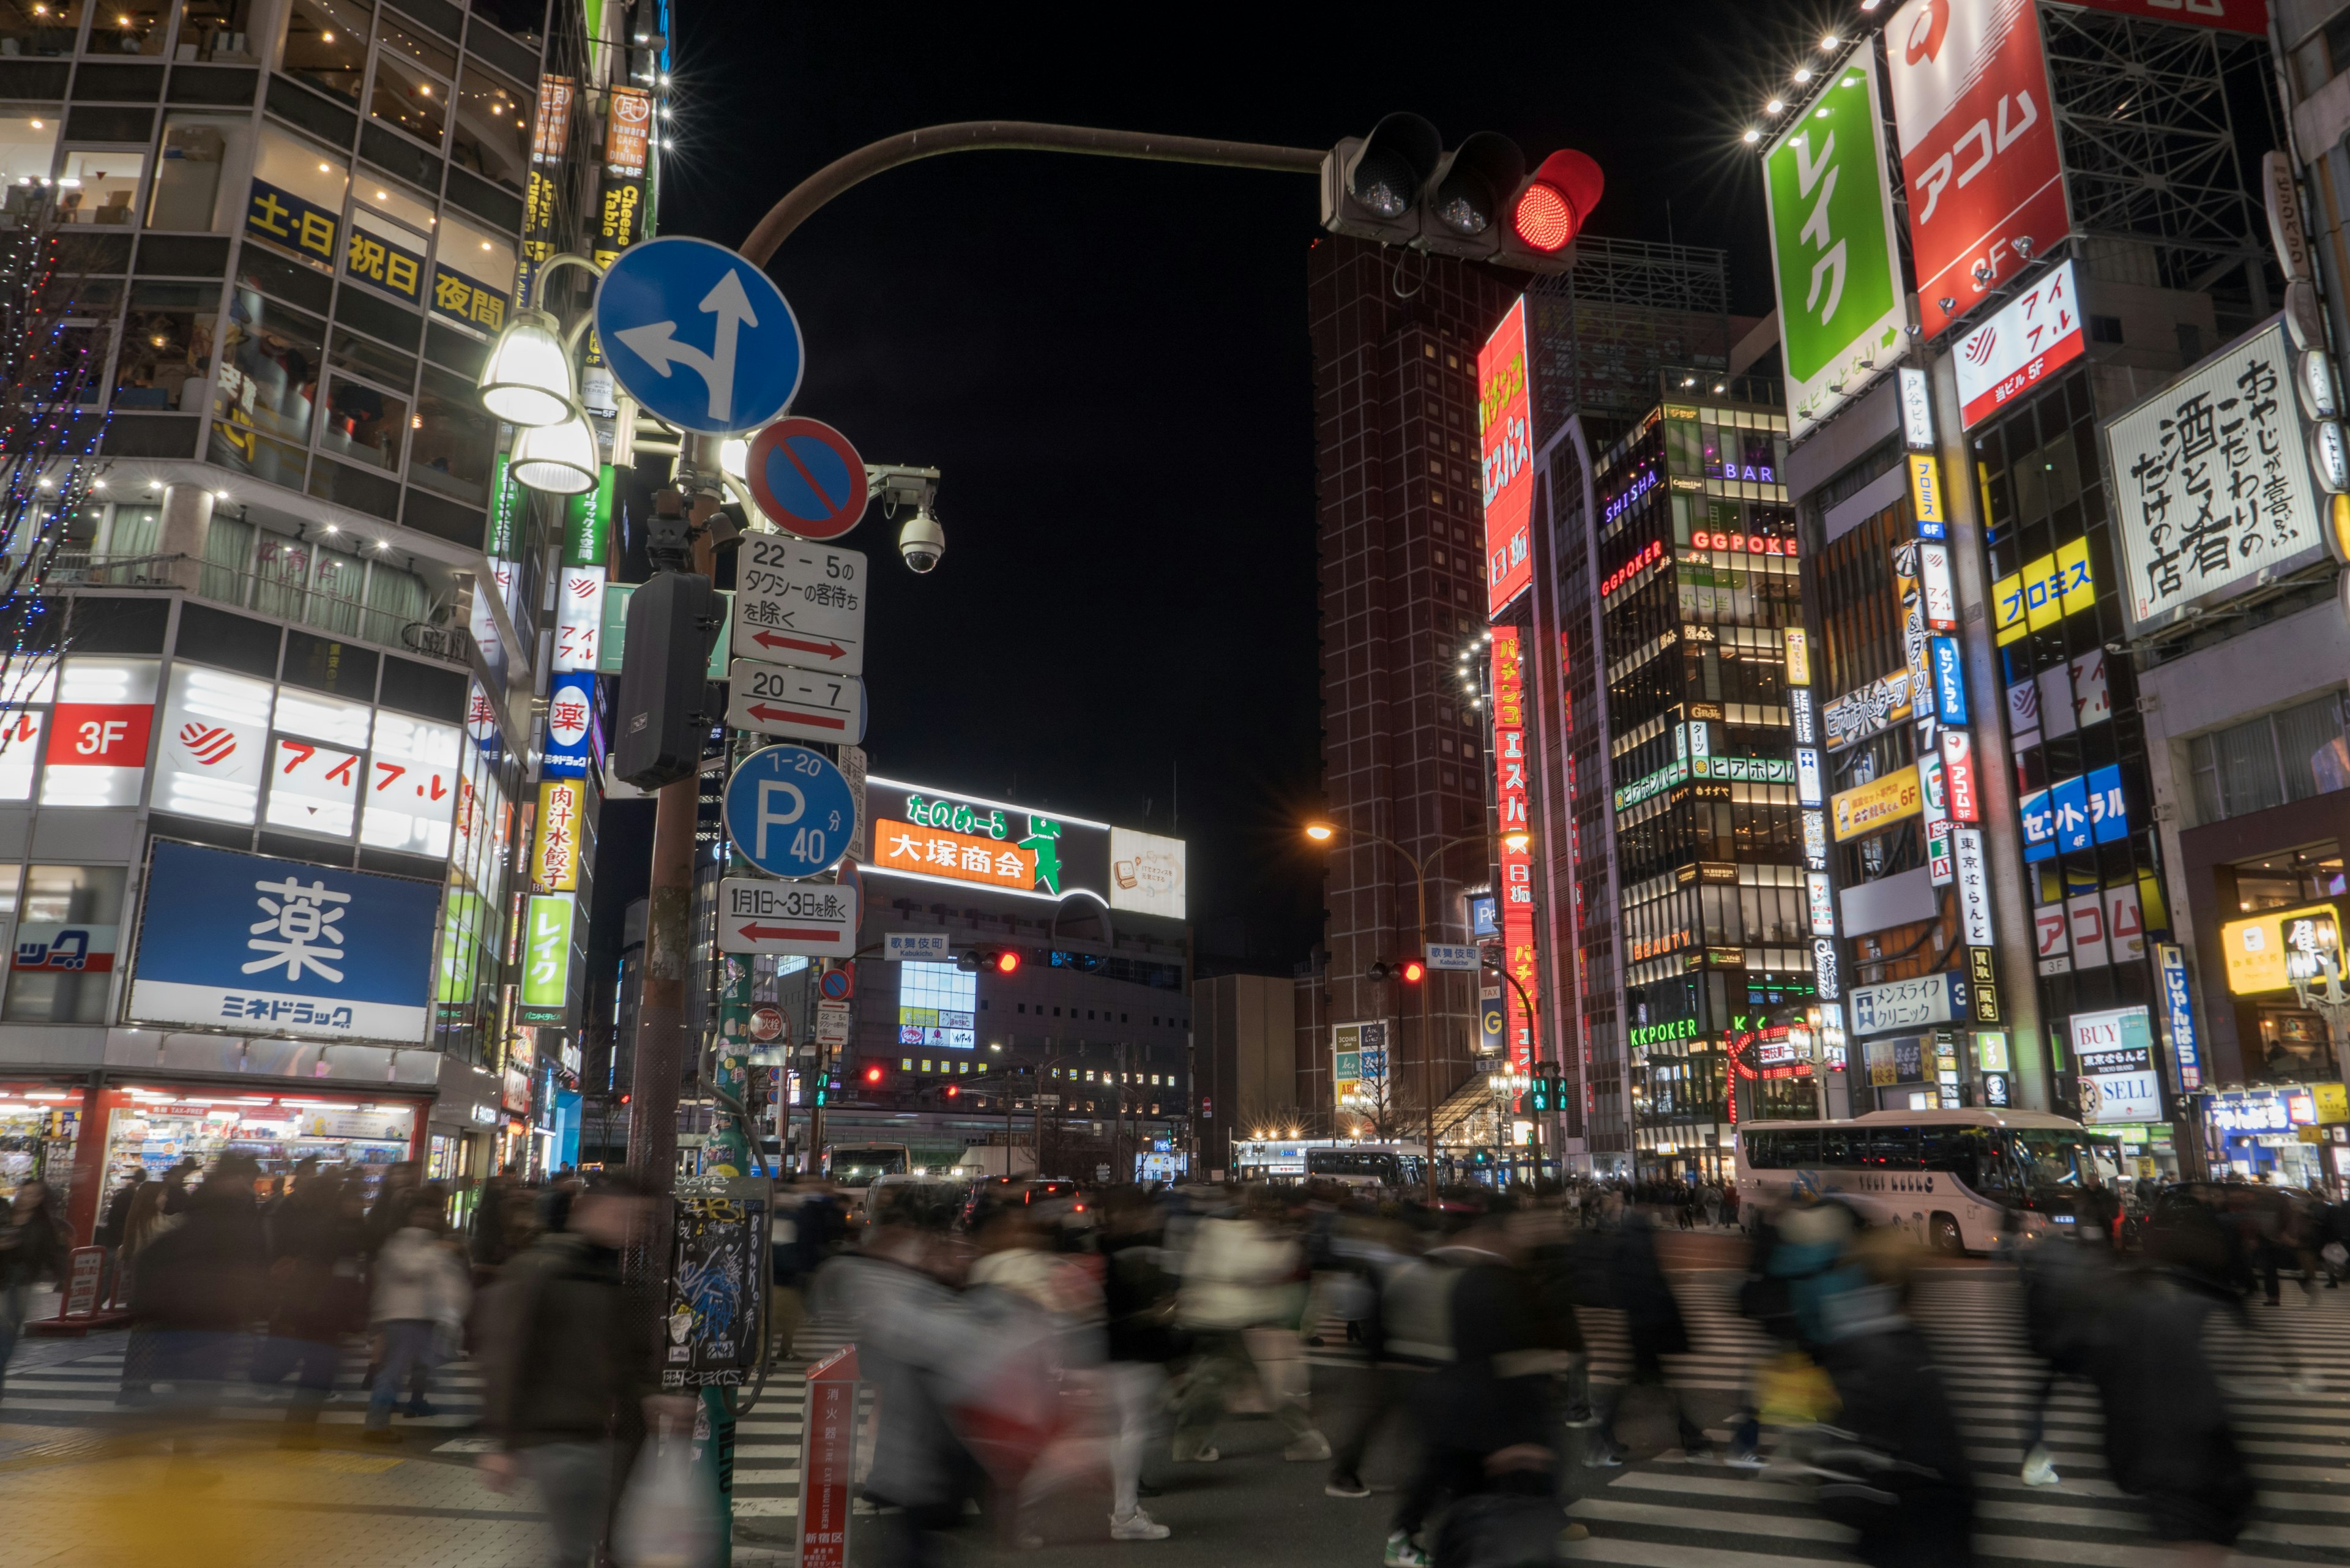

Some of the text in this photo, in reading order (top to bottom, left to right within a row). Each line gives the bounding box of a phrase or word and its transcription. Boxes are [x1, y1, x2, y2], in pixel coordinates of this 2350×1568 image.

[613, 122, 646, 137] kawara
[616, 135, 638, 146] CAFE
[610, 151, 643, 165] DINING
[625, 166, 642, 176] 8F
[1916, 89, 2037, 225] アコム
[602, 190, 621, 237] Table
[617, 185, 638, 246] Cheese
[1796, 129, 1846, 326] レイク
[249, 193, 334, 257] 土・日
[348, 234, 419, 296] 祝日
[435, 272, 505, 333] 夜間
[586, 356, 600, 364] 6F
[583, 387, 613, 395] TERRAC
[1479, 352, 1524, 437] パチンコ
[1996, 357, 2045, 403] 当ビル 5F
[602, 409, 616, 418] 5F
[1906, 376, 1924, 436] 戸谷ビル
[1482, 416, 1529, 510] エスパス
[1726, 462, 1774, 483] BAR
[2217, 398, 2264, 558] こだわりの
[1605, 470, 1657, 524] SHISHA
[1918, 463, 1934, 516] プロミス
[1923, 524, 1939, 534] 6F
[2130, 449, 2184, 604] だけの店
[1492, 526, 1528, 587] 日拓
[1692, 531, 1798, 556] GGPOKE
[1601, 540, 1662, 597] GGPOKER
[745, 570, 858, 611] タクシーの客待ち
[2002, 559, 2092, 622] プロミス
[744, 600, 795, 628] を除く
[1937, 621, 1949, 630] 5F
[1500, 640, 1520, 725] パチンコ
[1939, 647, 1958, 714] セントラル
[553, 701, 586, 732] 薬
[1692, 707, 1721, 719] GROVE
[1799, 690, 1811, 744] BUZZ STAND
[1826, 679, 1908, 737] ビアポン&ダーツ
[75, 721, 127, 755] 3F
[1693, 724, 1704, 752] ダーツ
[281, 740, 447, 802] アイフル
[1623, 769, 1678, 807] ビアポンバー
[1900, 786, 1915, 807] 6F
[1952, 766, 1970, 808] アコム
[756, 779, 805, 859] P
[907, 795, 1009, 839] たのめーる
[1958, 810, 1971, 819] 3F
[2023, 787, 2126, 843] セントラル
[543, 786, 575, 887] 肉汁水餃子
[790, 827, 825, 864] 40
[2072, 834, 2086, 847] 4F
[889, 833, 1024, 879] 大塚商会
[1142, 865, 1173, 877] ITでオフィスを
[1809, 857, 1826, 869] 7F
[532, 883, 545, 892] B1
[1142, 873, 1165, 882] 元気にする
[242, 876, 351, 983] 薬
[2037, 899, 2143, 955] アコム
[531, 913, 561, 984] レイク
[890, 936, 944, 949] 歌舞伎町
[1431, 947, 1476, 959] 歌舞伎町
[1633, 930, 1690, 960] BEAUTY
[1975, 952, 1990, 979] 買取
[2048, 960, 2063, 973] 3F
[1876, 980, 1939, 1006] メンズライフ
[1979, 990, 1996, 1018] 販売
[524, 1010, 562, 1021] パンドラビル
[1484, 1010, 1502, 1034] G
[1878, 1004, 1929, 1028] クリニック
[1630, 1018, 1696, 1047] KKPOKER
[2080, 1023, 2117, 1046] BUY
[1986, 1036, 1997, 1065] レイク
[2103, 1080, 2152, 1100] SELL
[170, 1106, 205, 1116] TAX-FREE
[825, 1388, 839, 1439] 消火器
[821, 1468, 832, 1529] EXTINGUISHER
[805, 1532, 843, 1544] 新宿区
